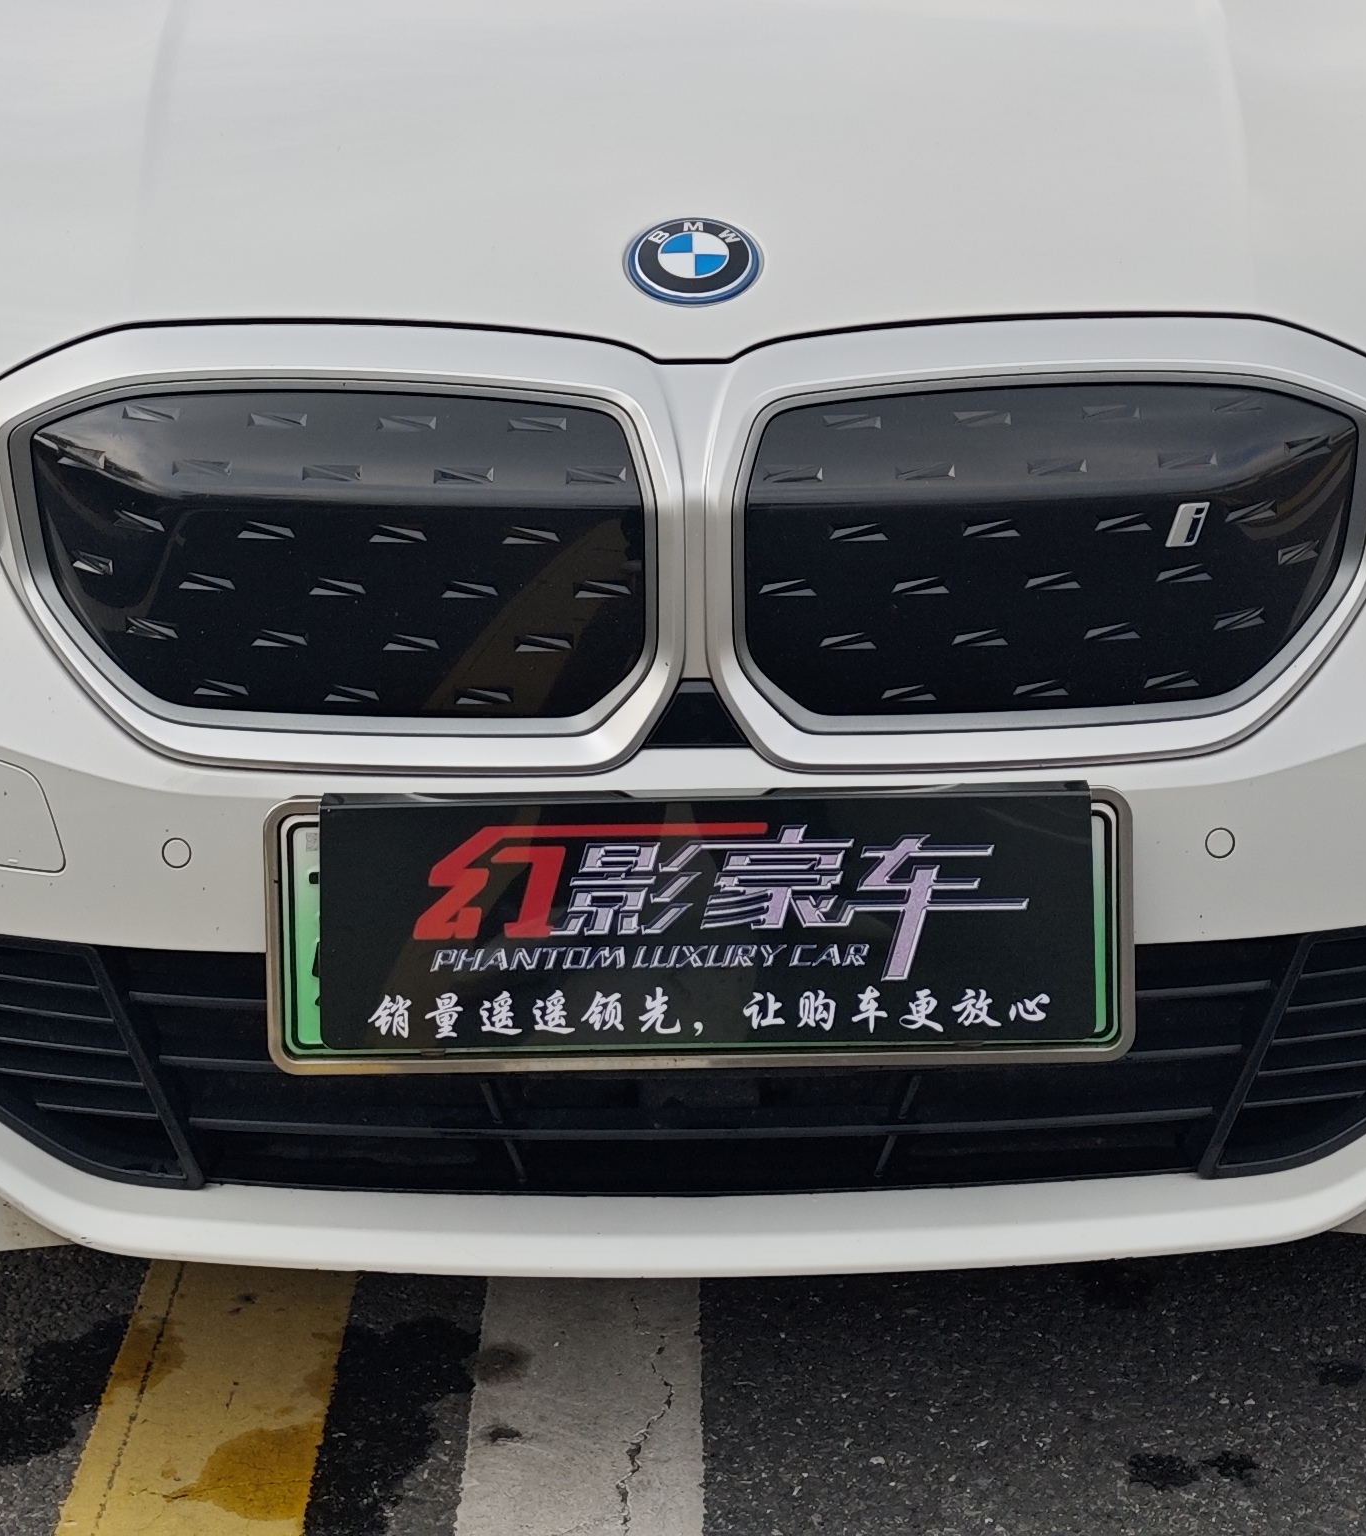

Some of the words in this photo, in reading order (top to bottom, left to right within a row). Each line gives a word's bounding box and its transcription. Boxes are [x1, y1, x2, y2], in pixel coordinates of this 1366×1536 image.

[647, 221, 742, 244] BMW
[413, 821, 1030, 983] 幻影豪车
[430, 944, 625, 973] PHANTOM
[631, 943, 788, 971] LUXURY
[788, 942, 871, 968] CAR
